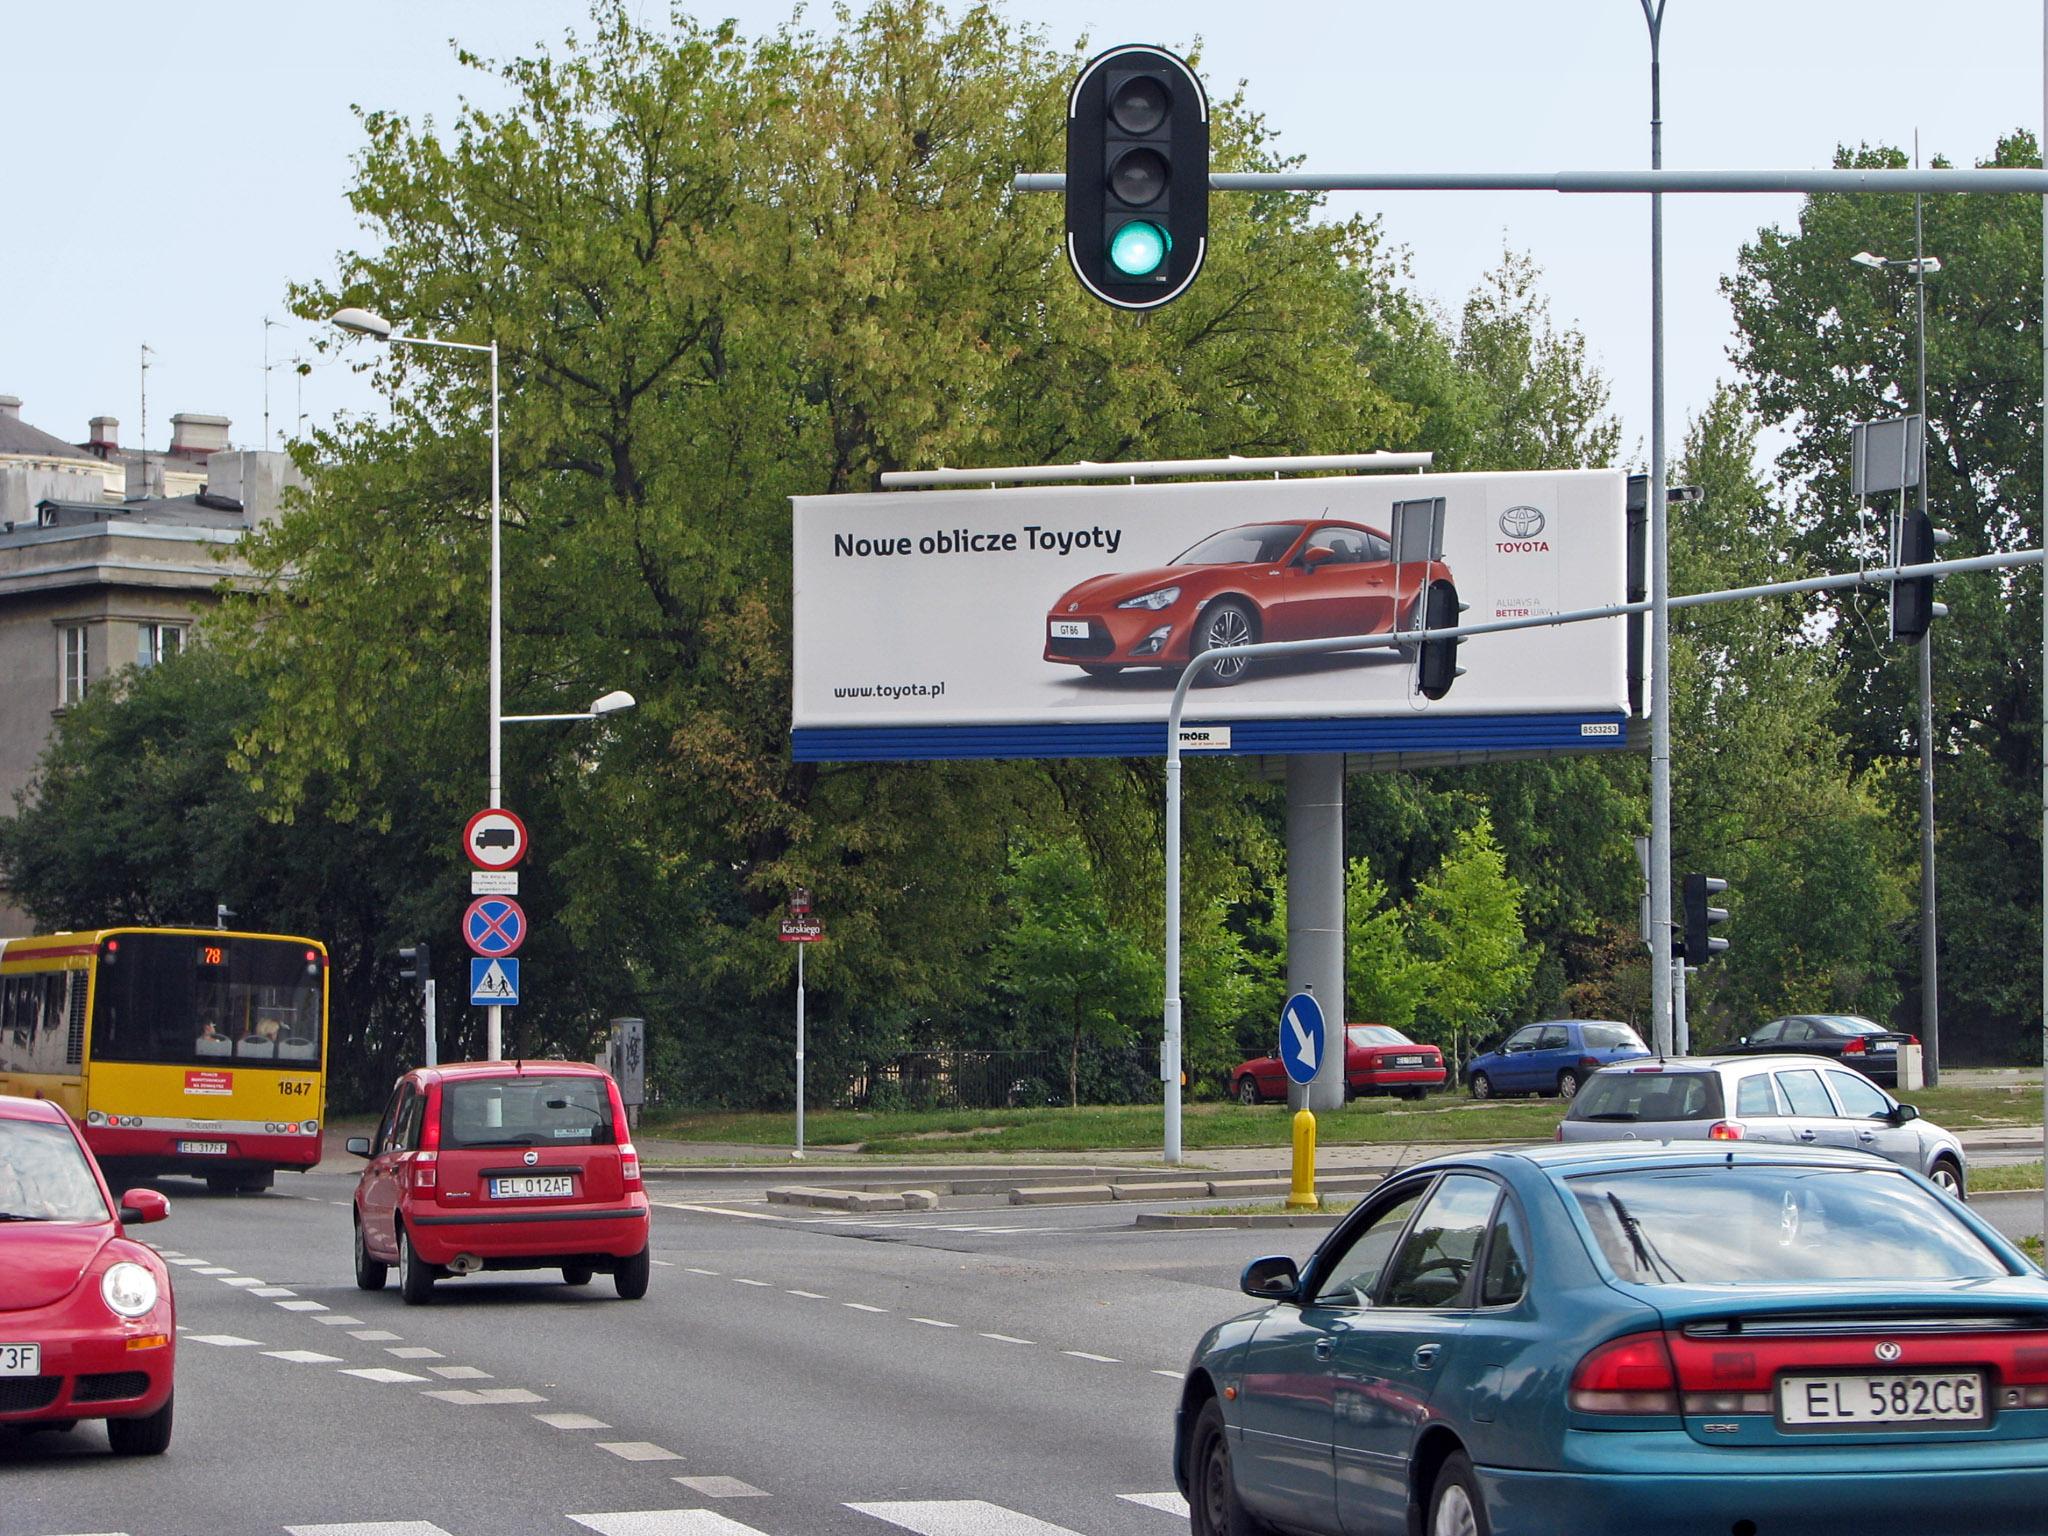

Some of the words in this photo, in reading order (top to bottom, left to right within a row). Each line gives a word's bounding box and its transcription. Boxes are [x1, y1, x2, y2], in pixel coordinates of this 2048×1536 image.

[834, 533, 912, 557] Nowe
[919, 529, 1017, 555] oblicze
[1023, 526, 1122, 556] Toyoty
[1495, 541, 1550, 553] TOYOTA
[1496, 598, 1533, 607] ALWAYS
[1495, 609, 1529, 618] BETTER
[834, 681, 945, 700] www.toyota.pl
[1179, 731, 1210, 741] TRÖER
[782, 924, 820, 937] Karskiego
[205, 947, 221, 964] 78
[278, 1081, 312, 1096] 1847
[183, 1143, 194, 1152] EL
[500, 1180, 519, 1194] EL
[525, 1177, 570, 1192] 012AF
[0, 1347, 34, 1369] 3F
[1806, 1382, 1854, 1418] EL
[1869, 1379, 1976, 1416] 582CG
[1703, 1422, 1739, 1433] 626
